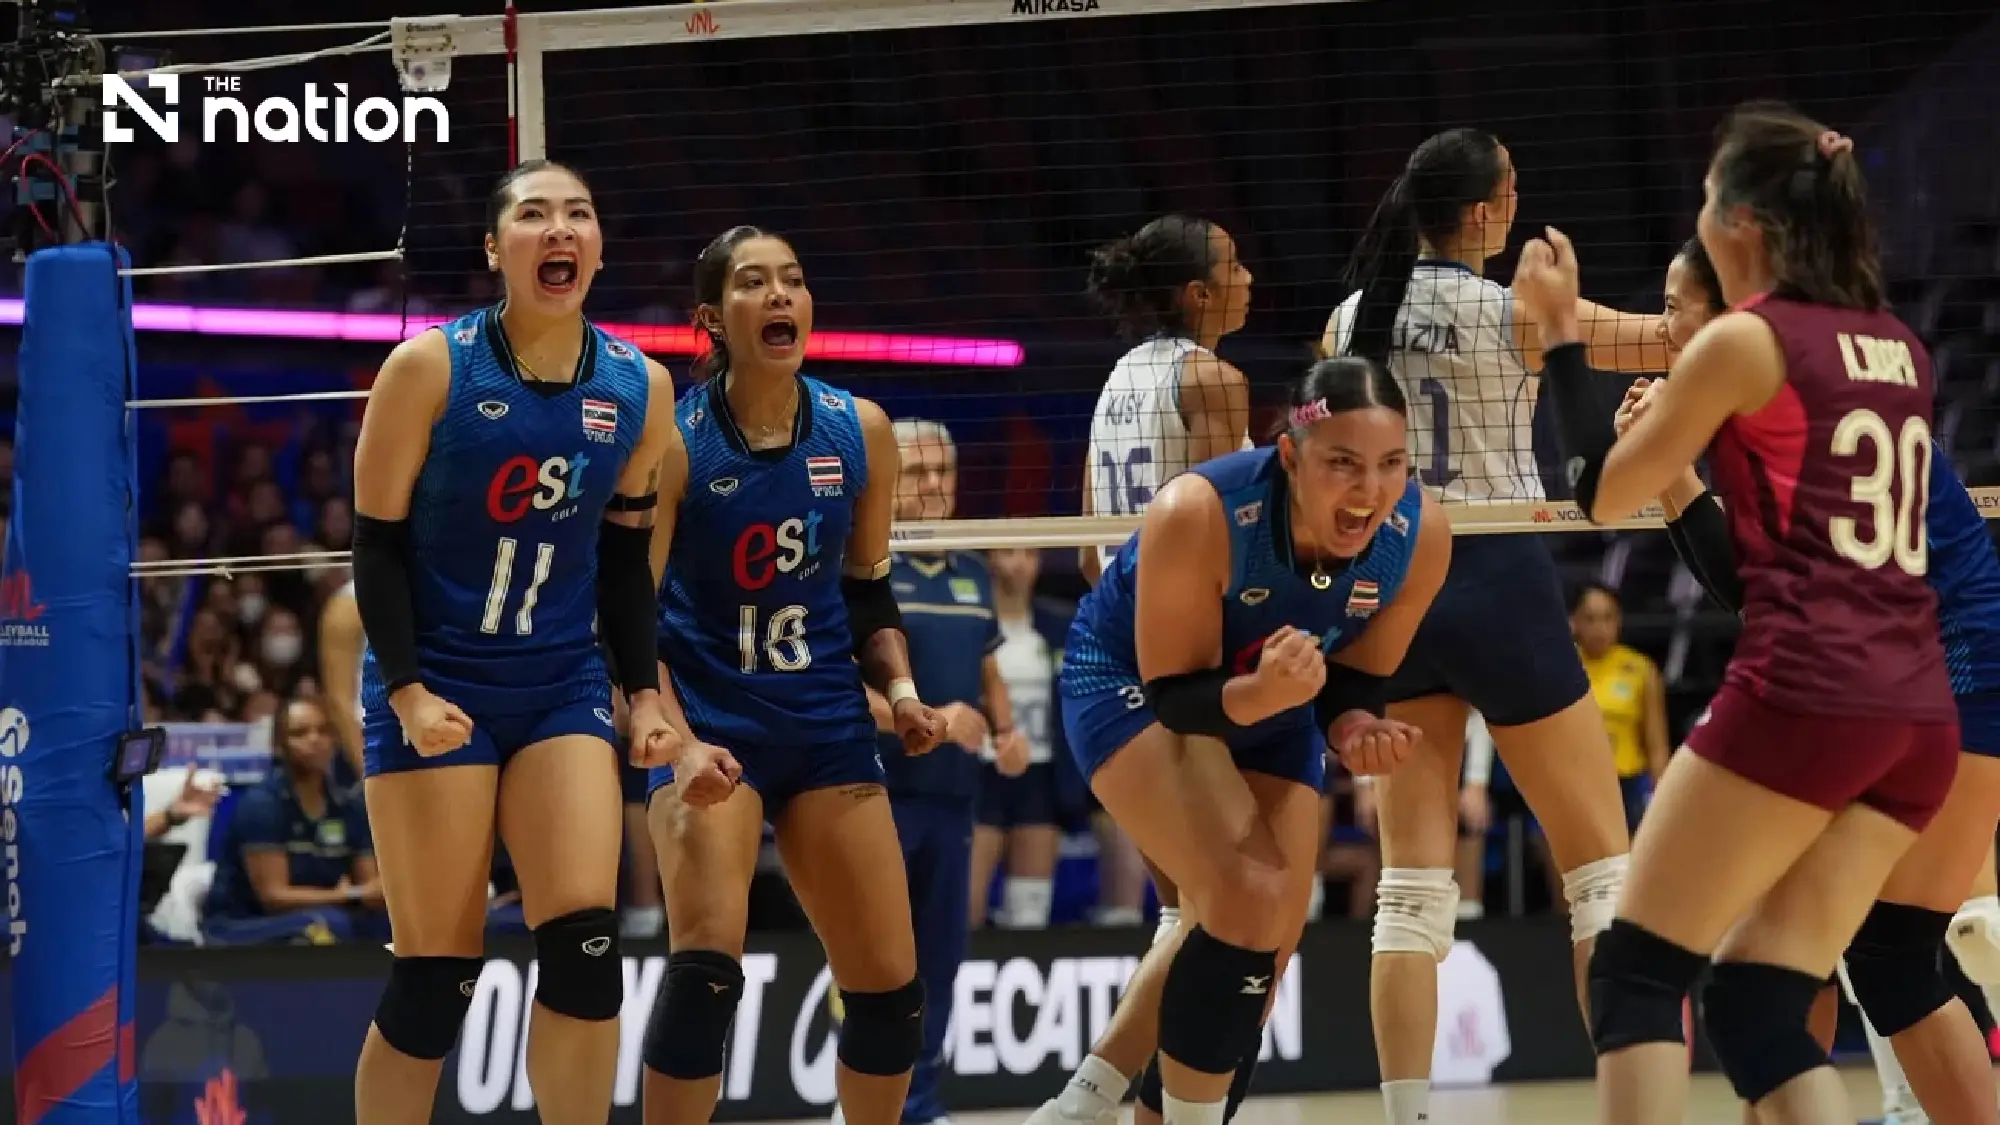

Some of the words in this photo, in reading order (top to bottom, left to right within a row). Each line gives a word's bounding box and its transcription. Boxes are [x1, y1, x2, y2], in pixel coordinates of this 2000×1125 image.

[1012, 0, 1099, 14] MIKASA
[1389, 324, 1461, 357] UZIA
[1106, 391, 1146, 425] KISY
[1419, 378, 1463, 486] 1
[487, 451, 591, 523] est
[1829, 408, 1932, 577] 30
[480, 536, 555, 636] 11
[733, 508, 823, 591] est
